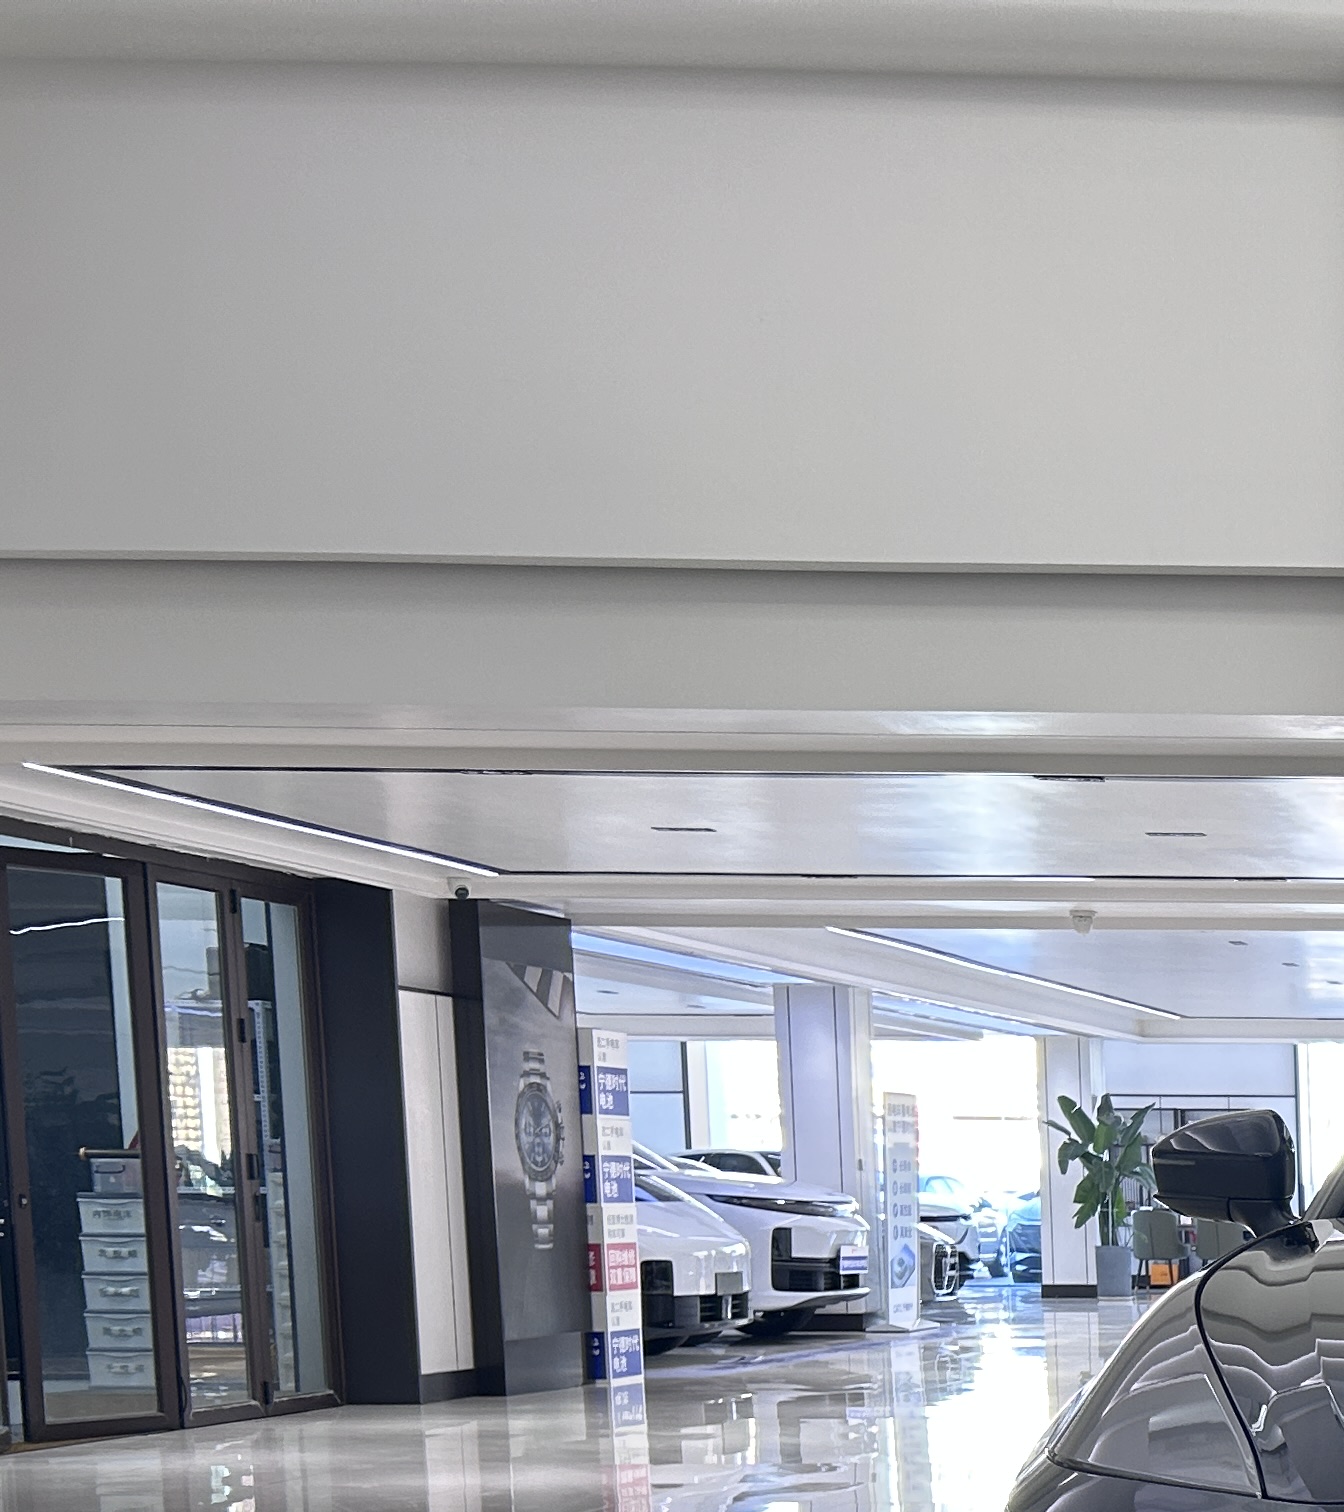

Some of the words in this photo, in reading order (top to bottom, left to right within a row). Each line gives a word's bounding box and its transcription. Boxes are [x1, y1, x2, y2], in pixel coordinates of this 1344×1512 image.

[598, 1072, 627, 1093] 宁德时代
[600, 1092, 614, 1110] 电池
[602, 1161, 631, 1179] 宁德时代
[604, 1180, 619, 1198] 电池
[612, 1334, 640, 1354] 宁德时代
[613, 1355, 628, 1373] 电池
